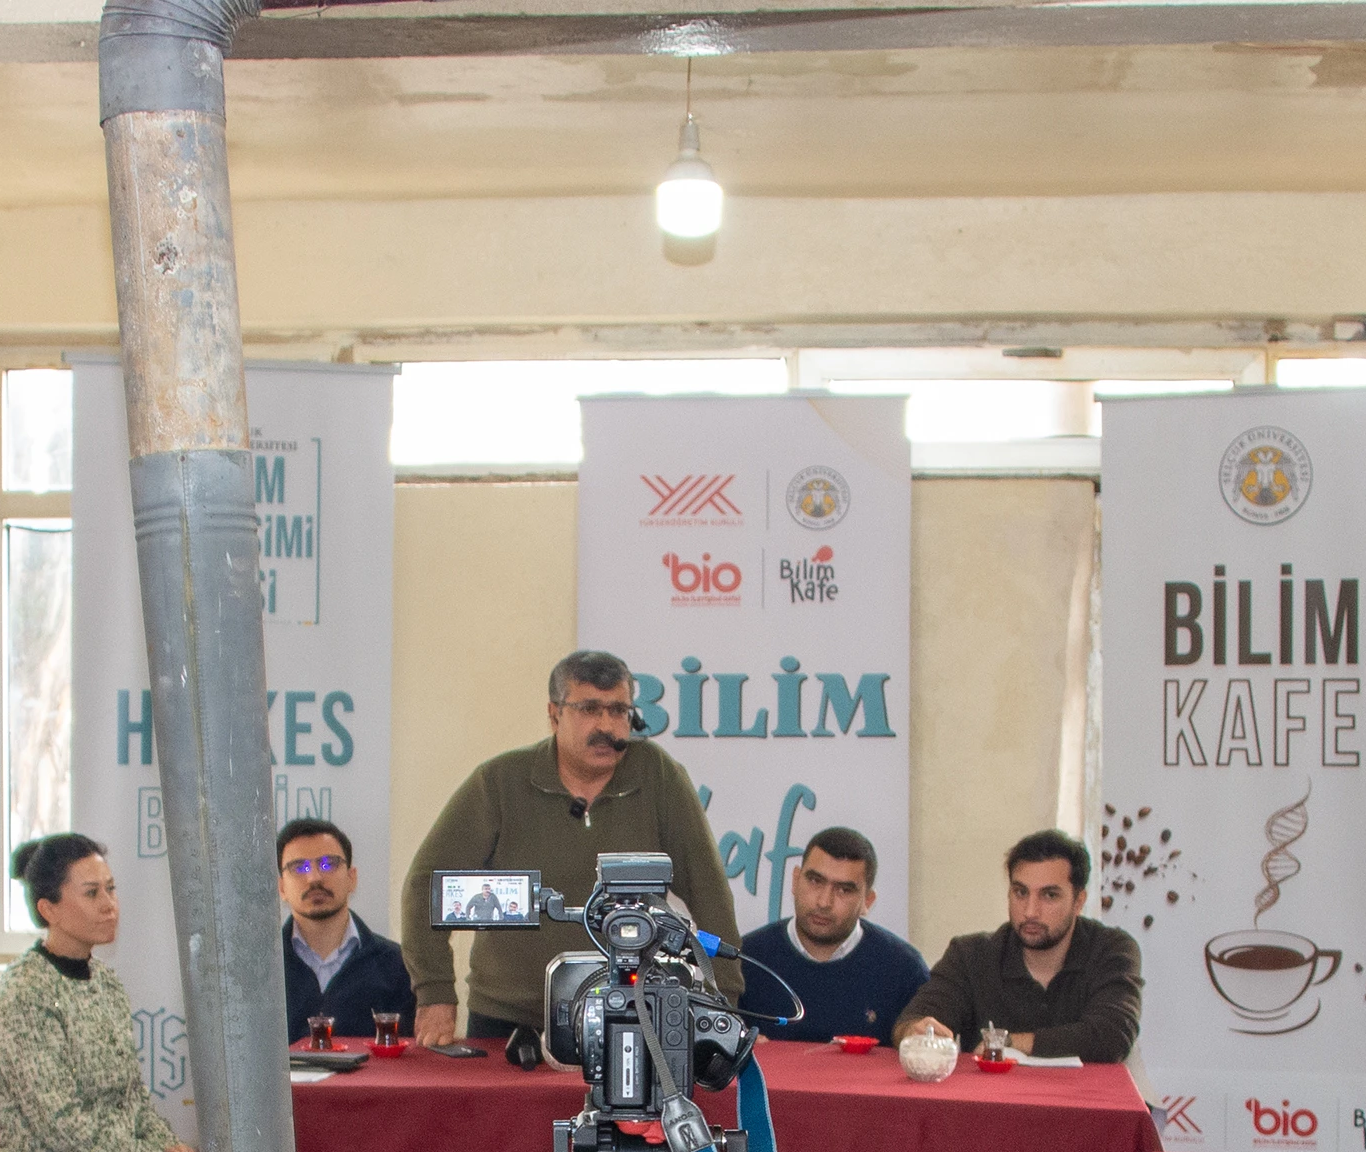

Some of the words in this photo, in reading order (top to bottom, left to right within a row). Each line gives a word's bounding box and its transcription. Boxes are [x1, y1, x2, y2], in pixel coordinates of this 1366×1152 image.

[780, 558, 835, 581] Bilim
[790, 578, 839, 603] Kafe
[1164, 563, 1360, 666] BİLİM
[117, 689, 355, 767] HES
[631, 655, 897, 739] BİLİM
[1163, 678, 1361, 767] KAFE
[1245, 1098, 1318, 1137] bio
